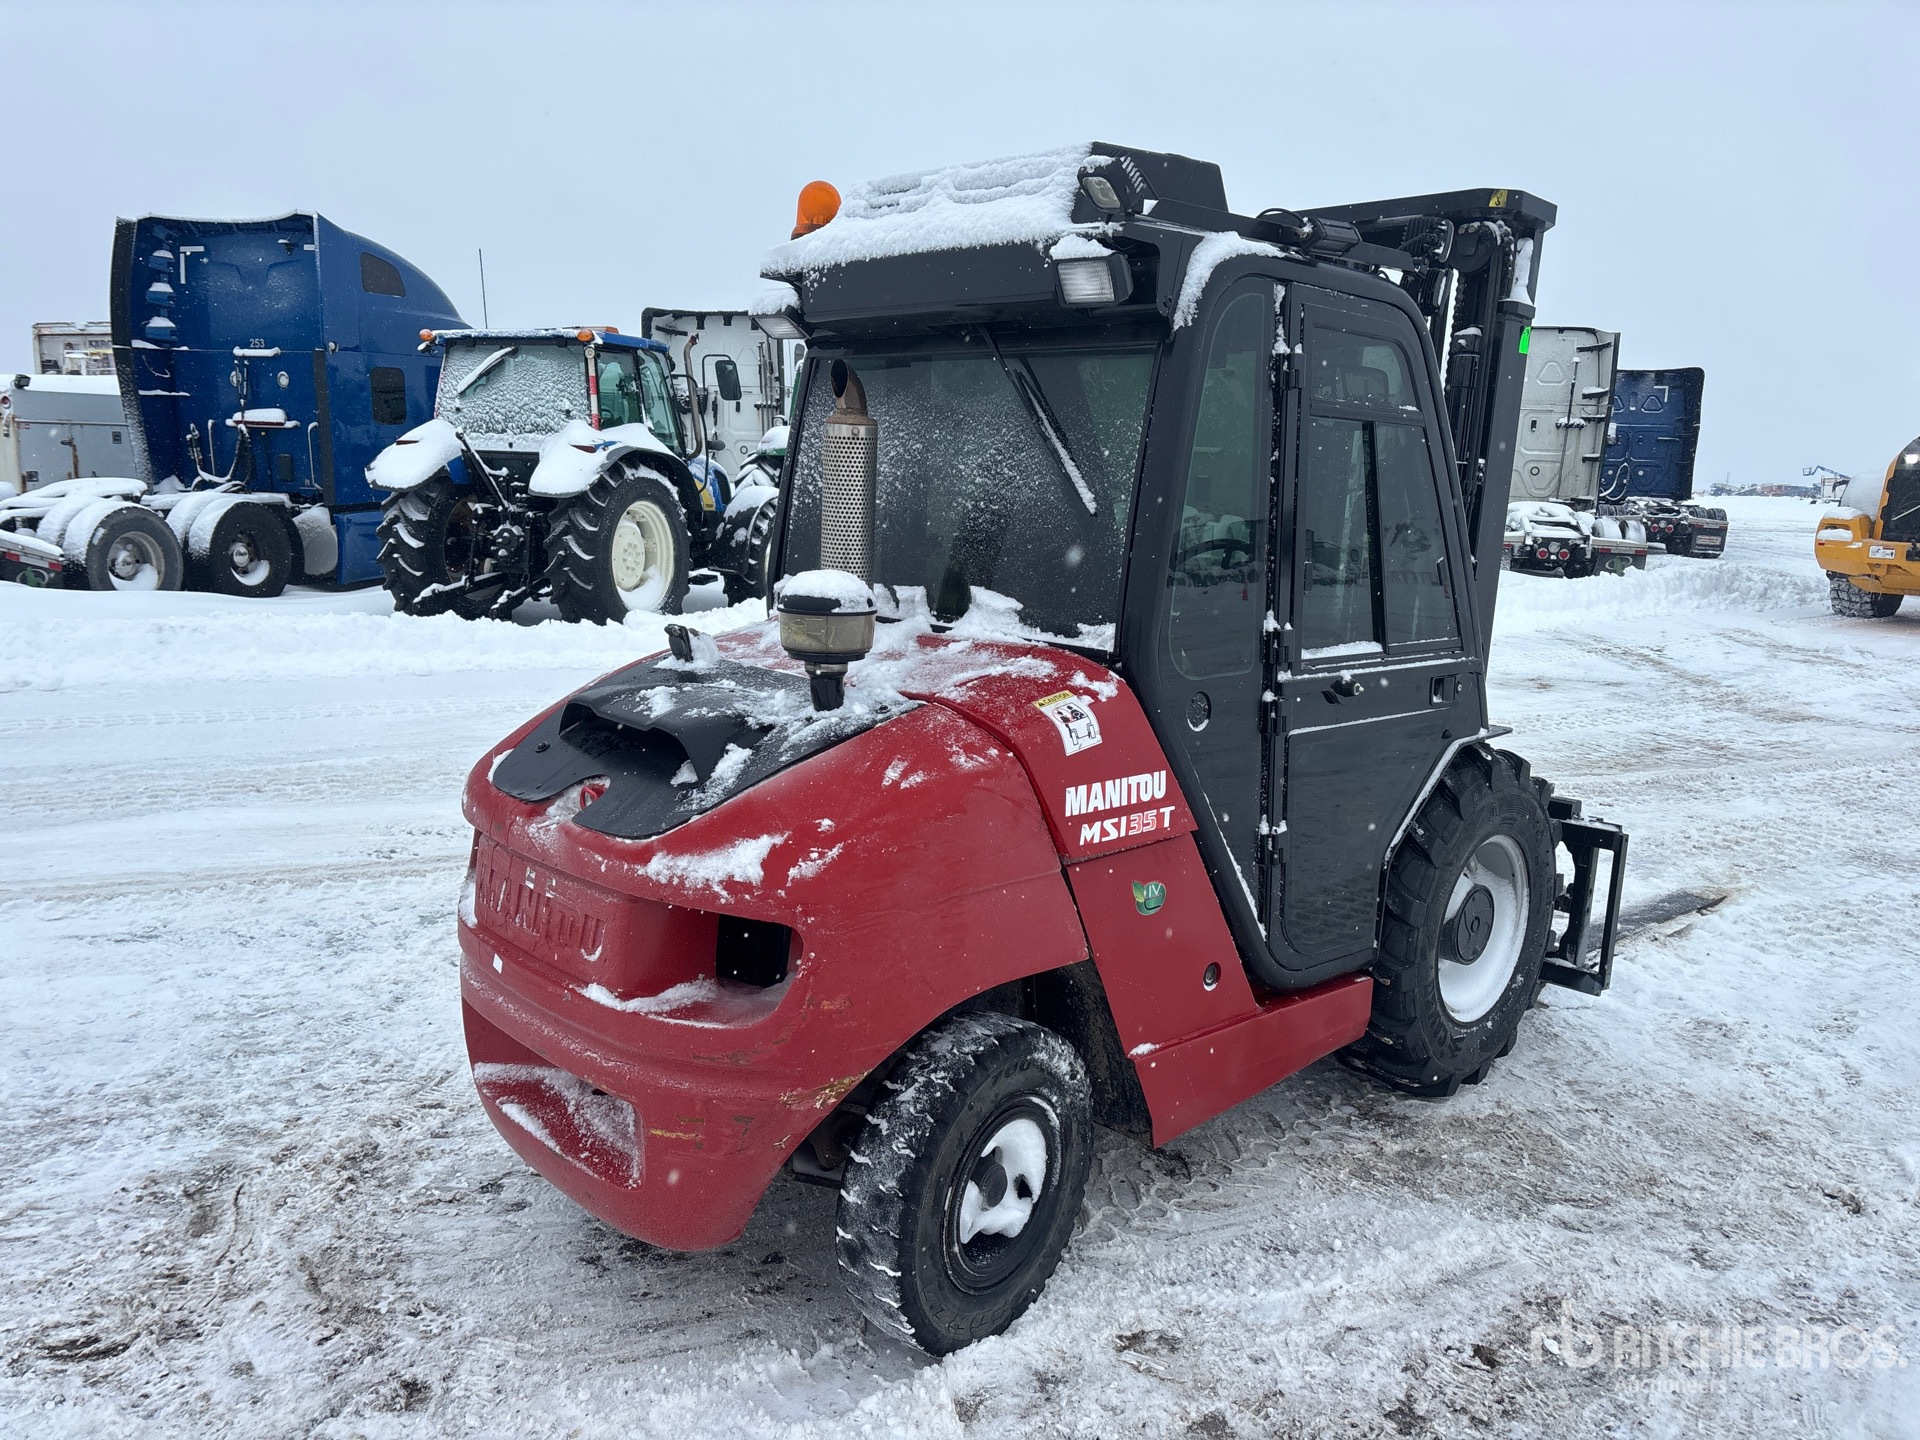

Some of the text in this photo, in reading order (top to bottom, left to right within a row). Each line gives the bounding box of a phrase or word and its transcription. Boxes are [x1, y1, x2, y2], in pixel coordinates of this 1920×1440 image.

[249, 338, 265, 348] 253
[1042, 692, 1070, 704] CAUTION
[1065, 770, 1166, 817] MANITOU
